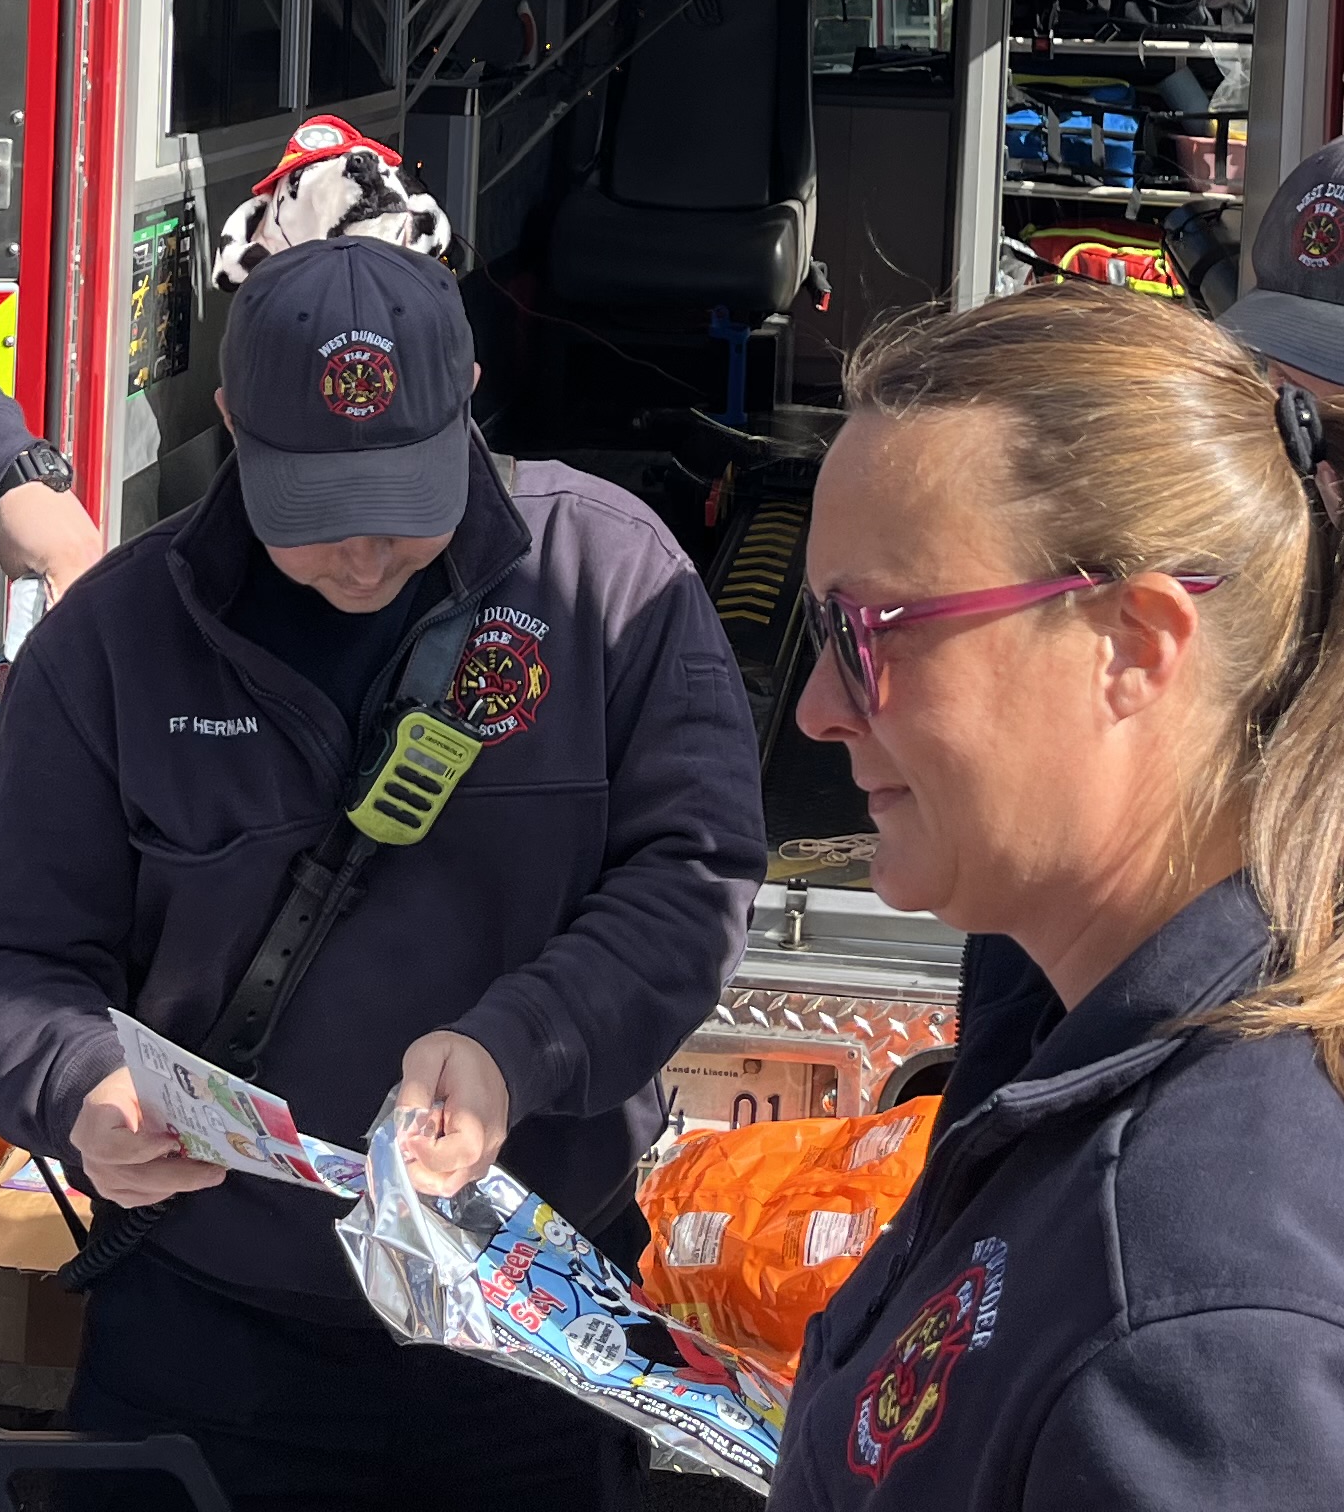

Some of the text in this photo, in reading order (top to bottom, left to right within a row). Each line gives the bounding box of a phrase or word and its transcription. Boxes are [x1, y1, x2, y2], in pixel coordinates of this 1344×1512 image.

[1296, 184, 1324, 212] WEST
[318, 330, 394, 358] WEST DUNDEE
[344, 351, 371, 362] FIRE
[346, 405, 375, 417] DEPT
[484, 606, 550, 642] DUNDEE
[474, 630, 513, 648] FIRE
[169, 716, 189, 734] FF
[479, 715, 518, 737] SCUE
[666, 1065, 739, 1078] Land of Lincoln
